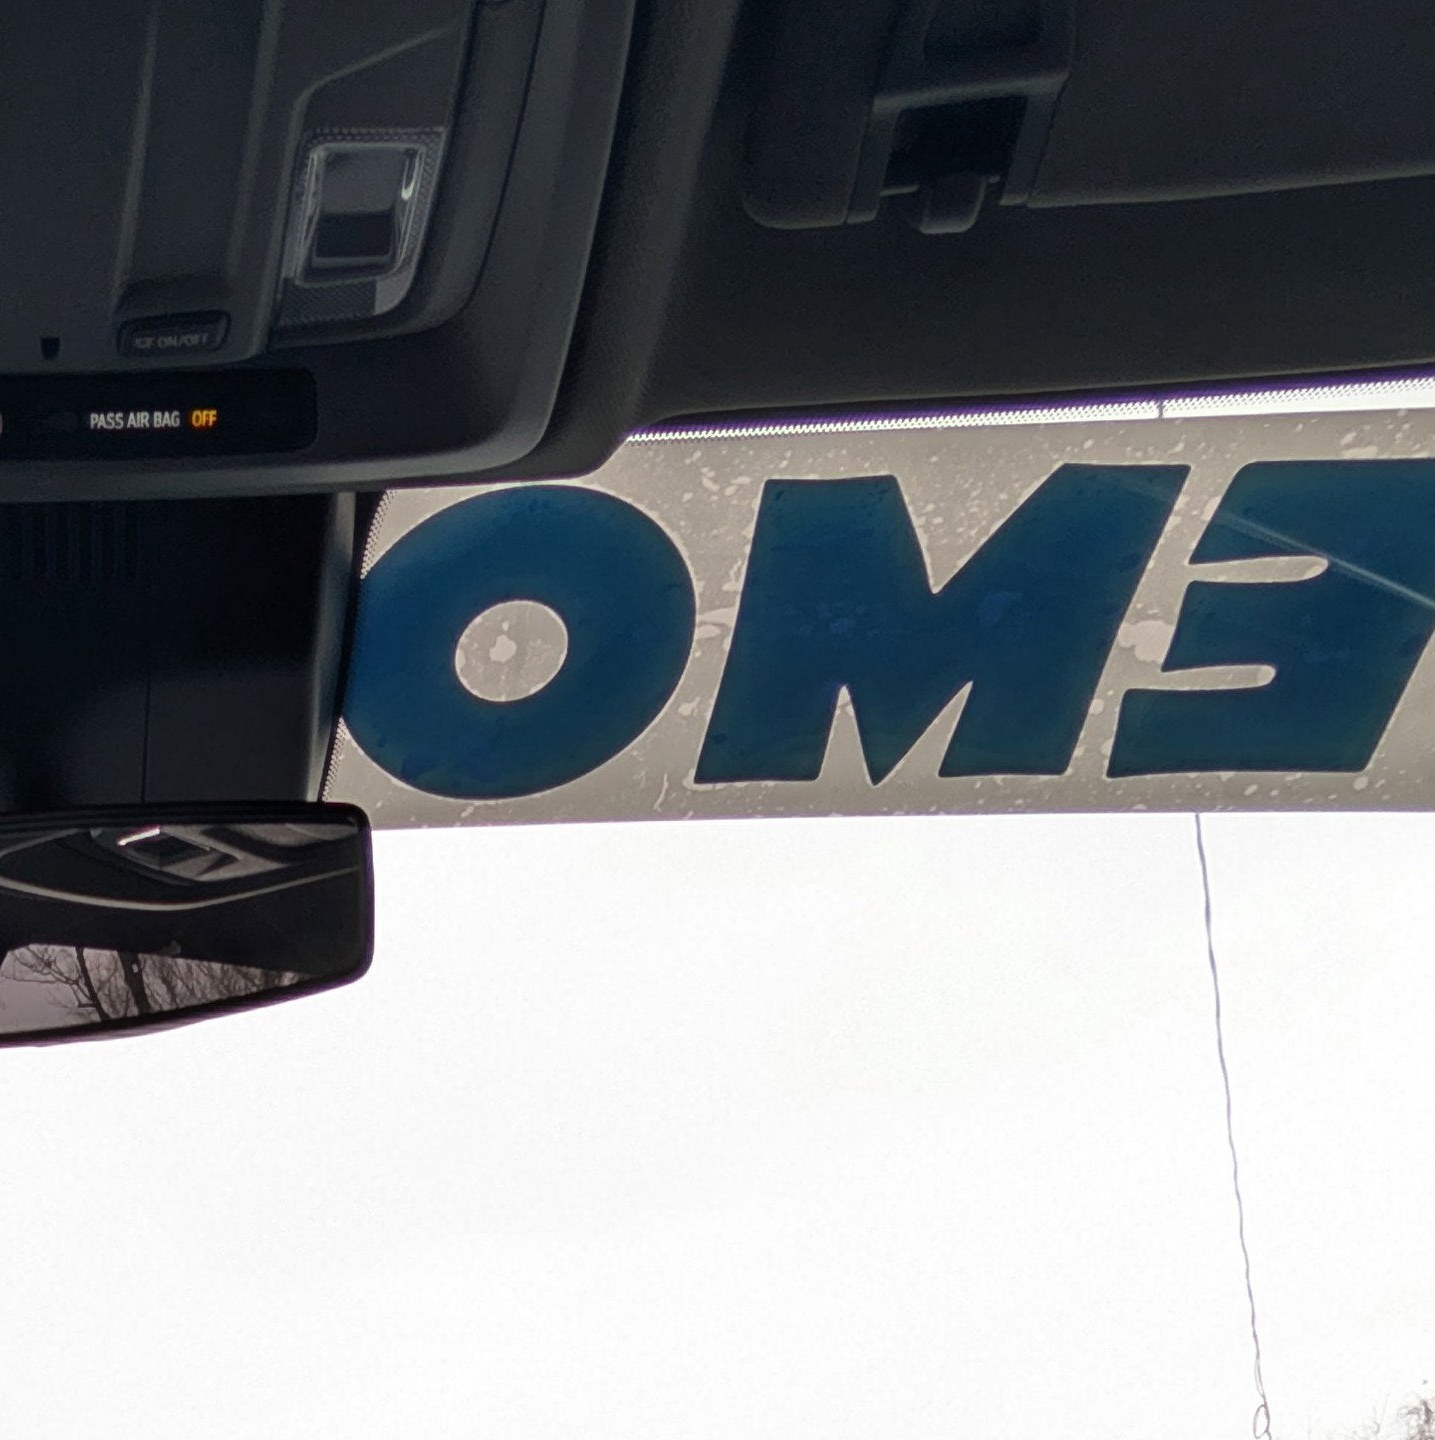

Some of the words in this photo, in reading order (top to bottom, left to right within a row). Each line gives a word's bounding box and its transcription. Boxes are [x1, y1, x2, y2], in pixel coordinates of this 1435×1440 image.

[156, 333, 210, 347] ON/OFF
[89, 413, 124, 430] PASS
[127, 412, 150, 429] AIR
[153, 411, 181, 428] BAG
[191, 410, 217, 427] OFF
